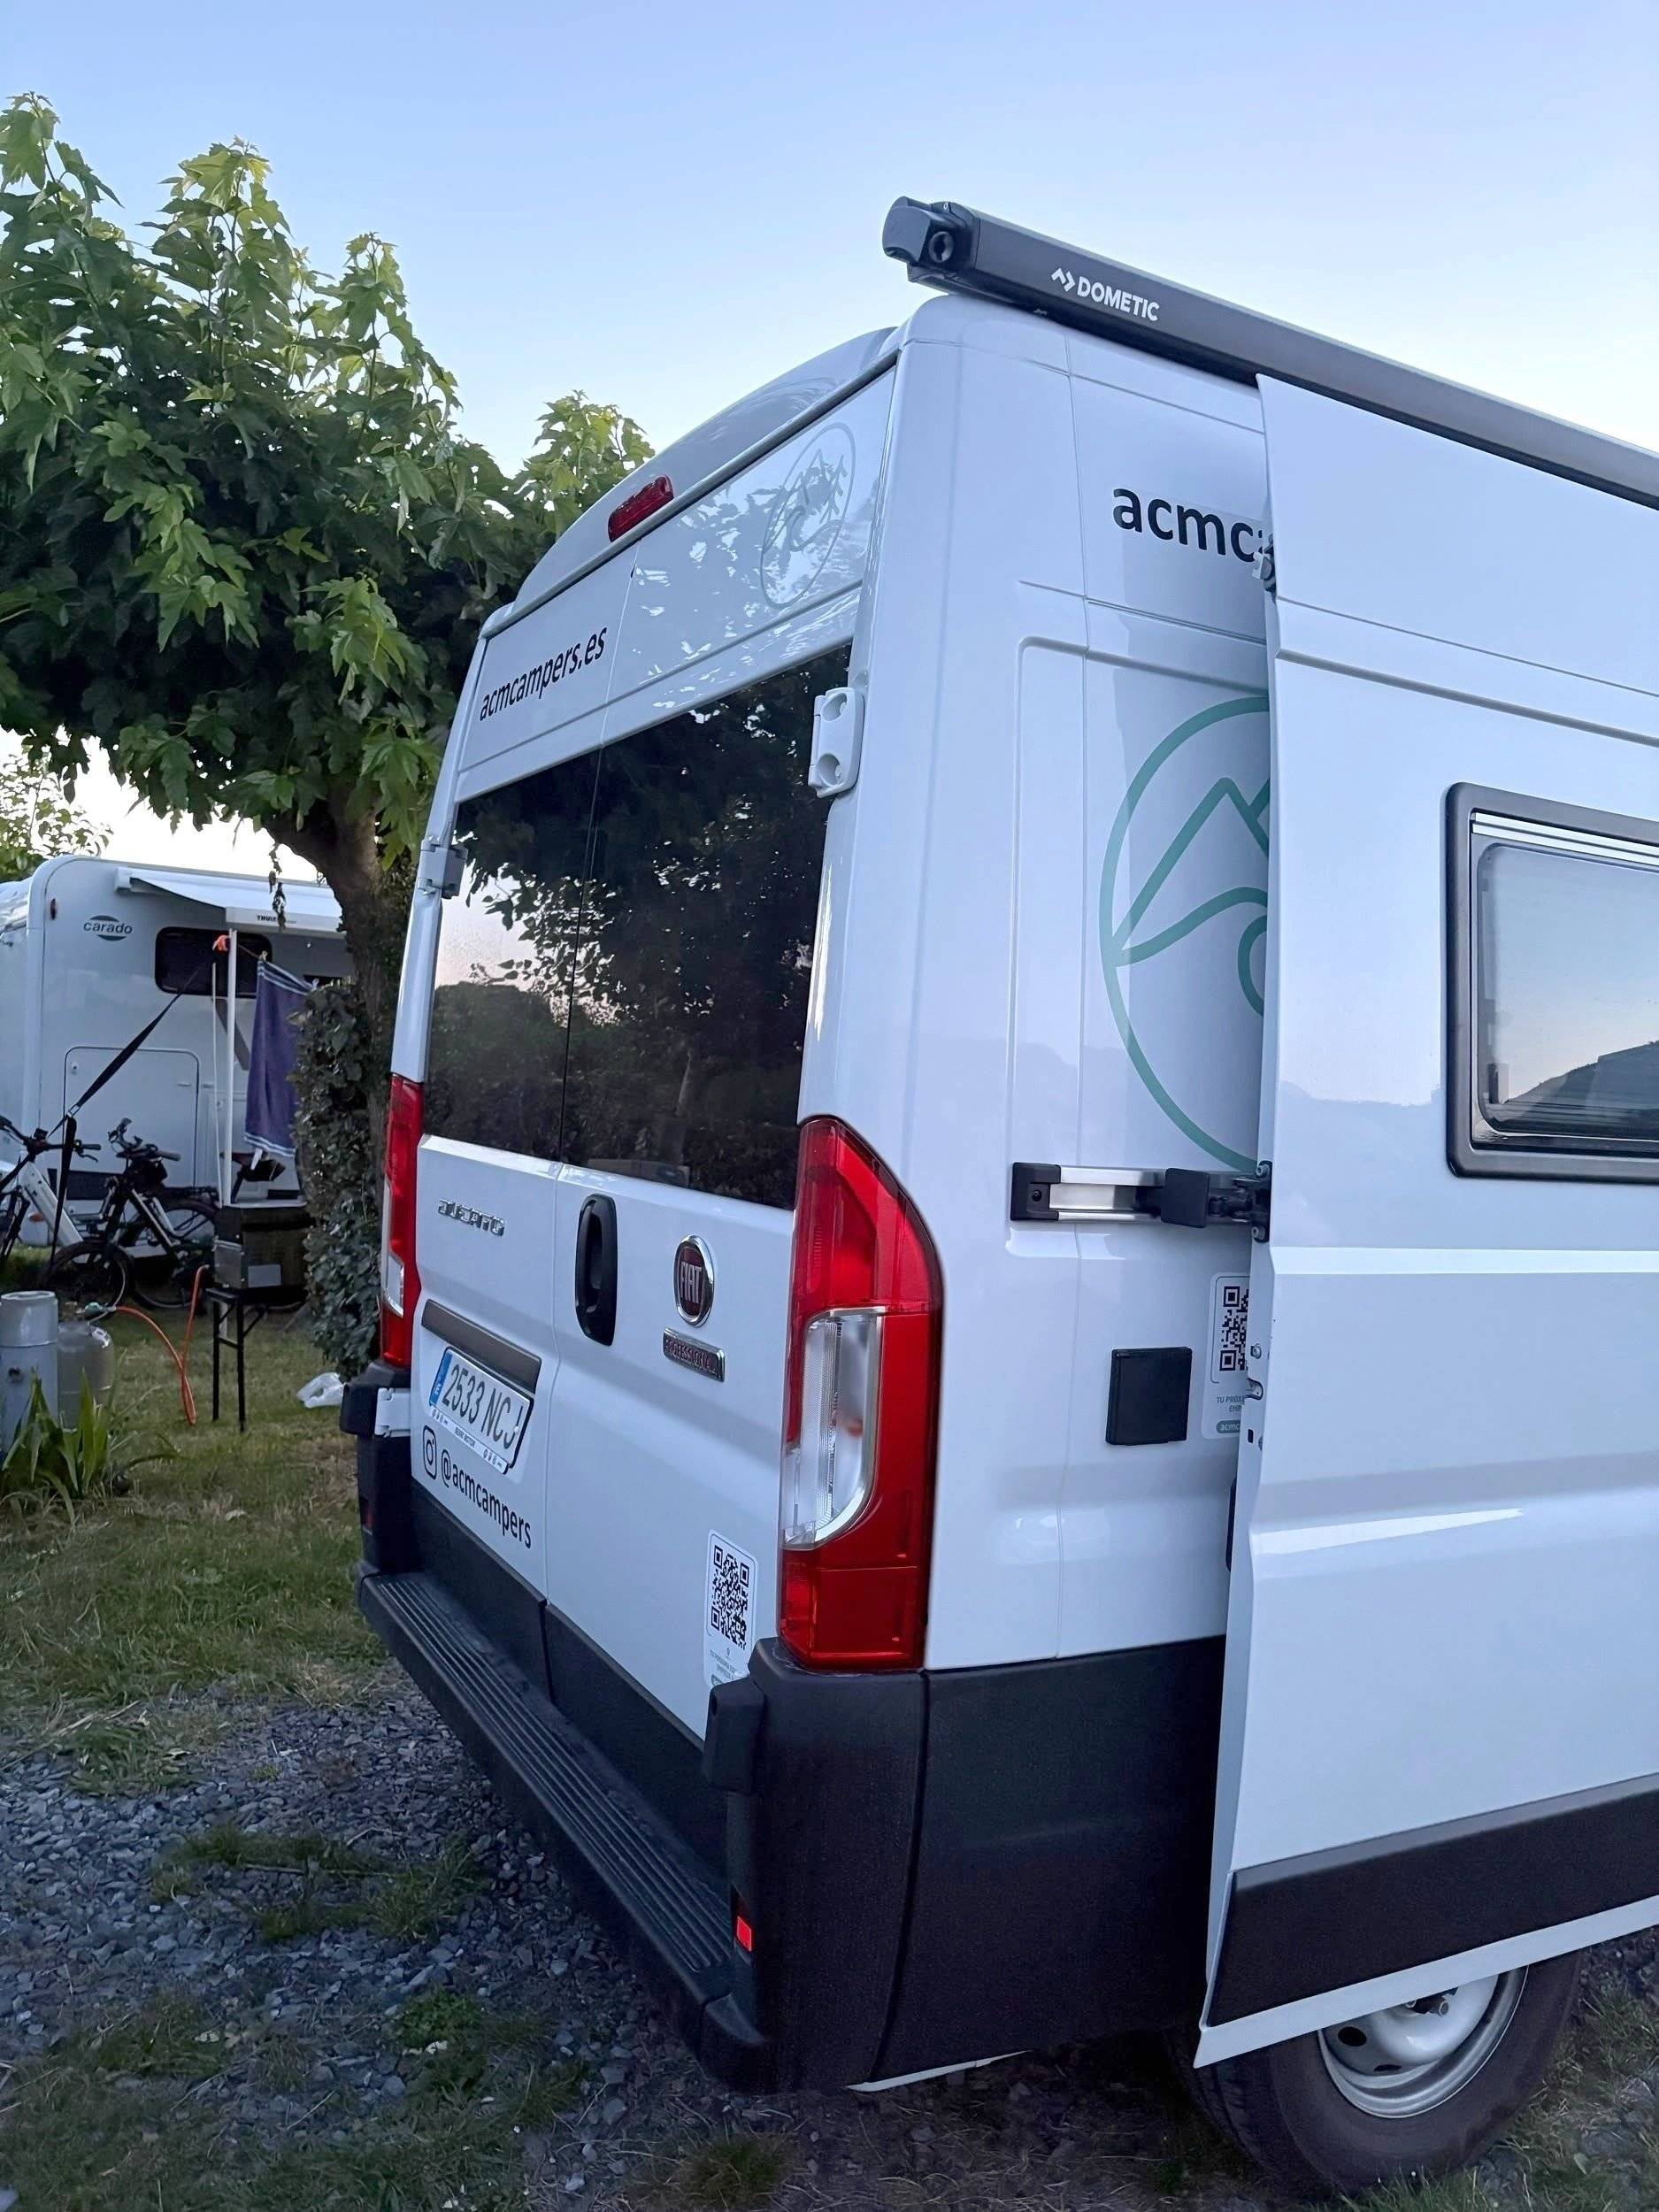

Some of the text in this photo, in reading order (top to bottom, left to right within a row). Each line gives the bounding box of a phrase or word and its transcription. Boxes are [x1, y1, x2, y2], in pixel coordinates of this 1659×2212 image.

[1077, 276, 1160, 321] DOMETIC
[480, 627, 608, 721] acmcampers.es
[83, 922, 133, 934] carado
[680, 1262, 703, 1304] FIAT
[442, 1363, 485, 1424] 2533
[480, 1388, 524, 1449] NCJ
[442, 1449, 531, 1548] @acmcampers
